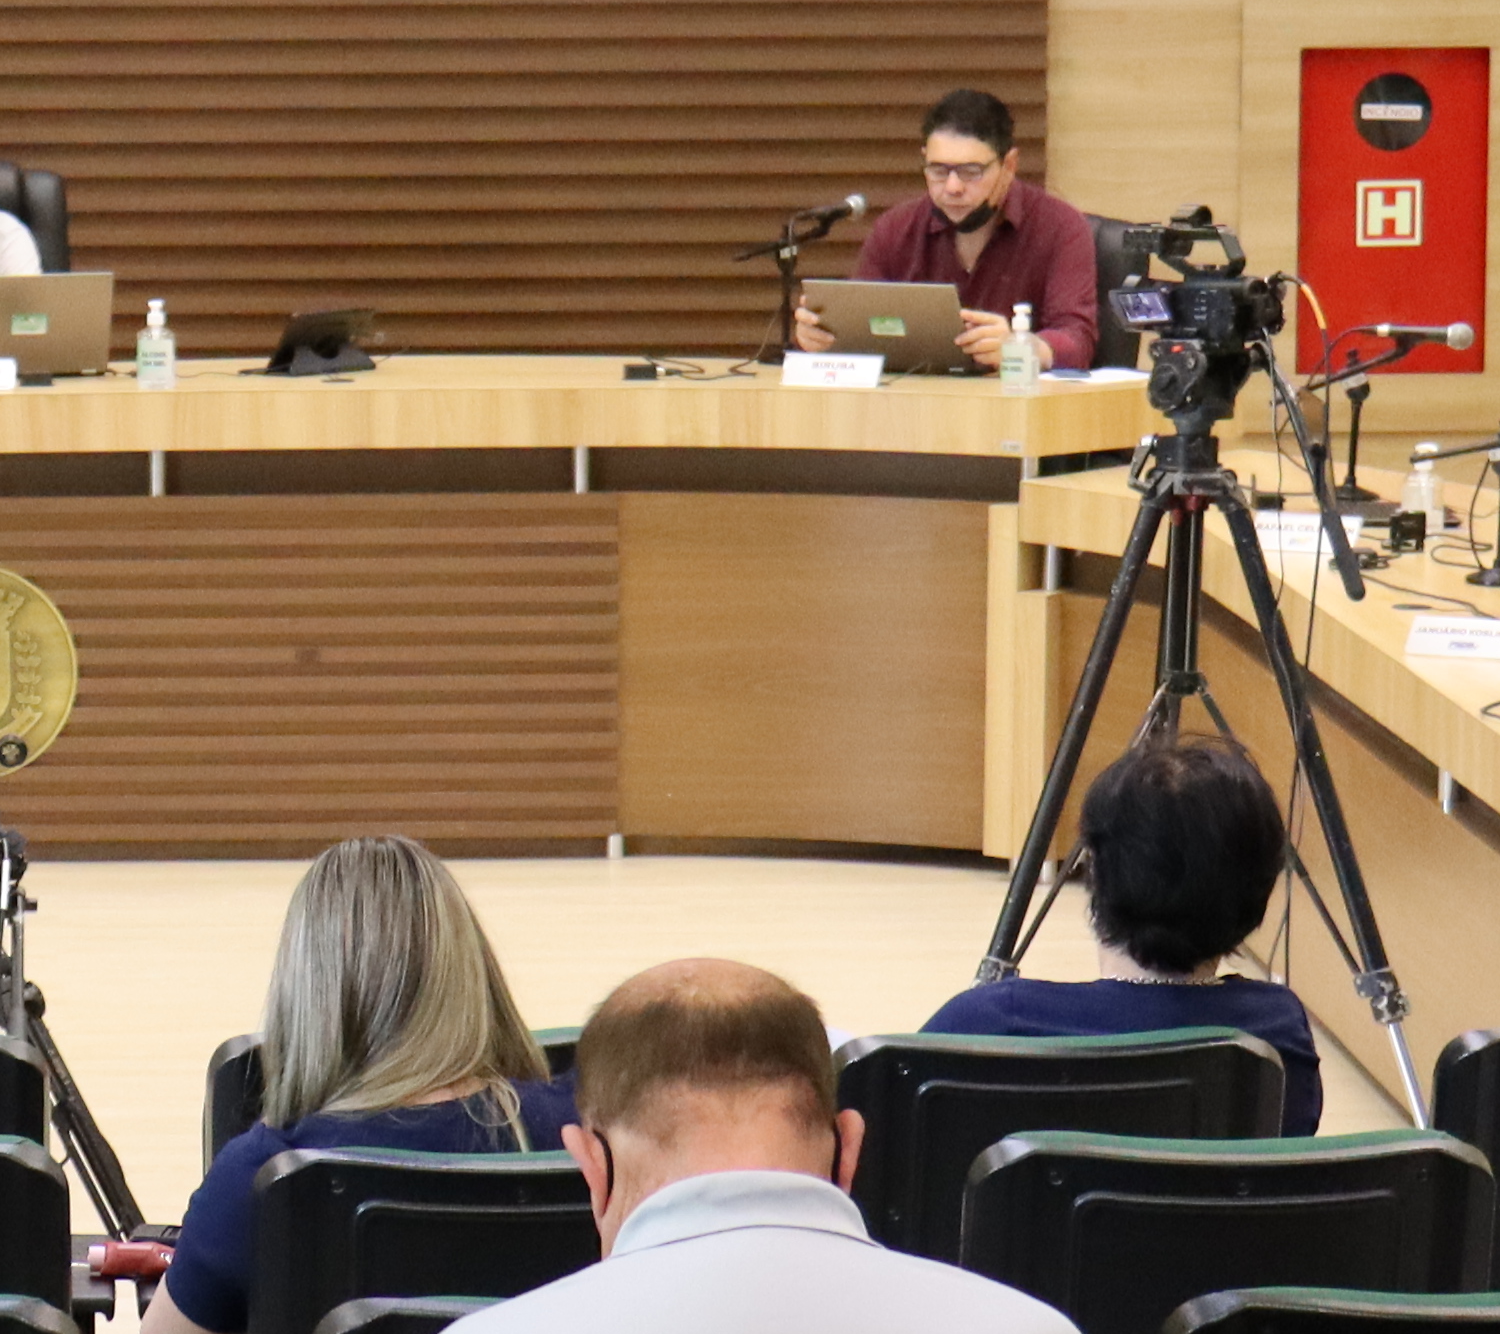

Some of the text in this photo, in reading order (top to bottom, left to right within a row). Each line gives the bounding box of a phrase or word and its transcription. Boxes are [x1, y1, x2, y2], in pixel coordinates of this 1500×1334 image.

[1361, 104, 1422, 119] INCÊNDIO
[1366, 190, 1412, 236] H
[1414, 625, 1468, 636] JANUÁRIO
